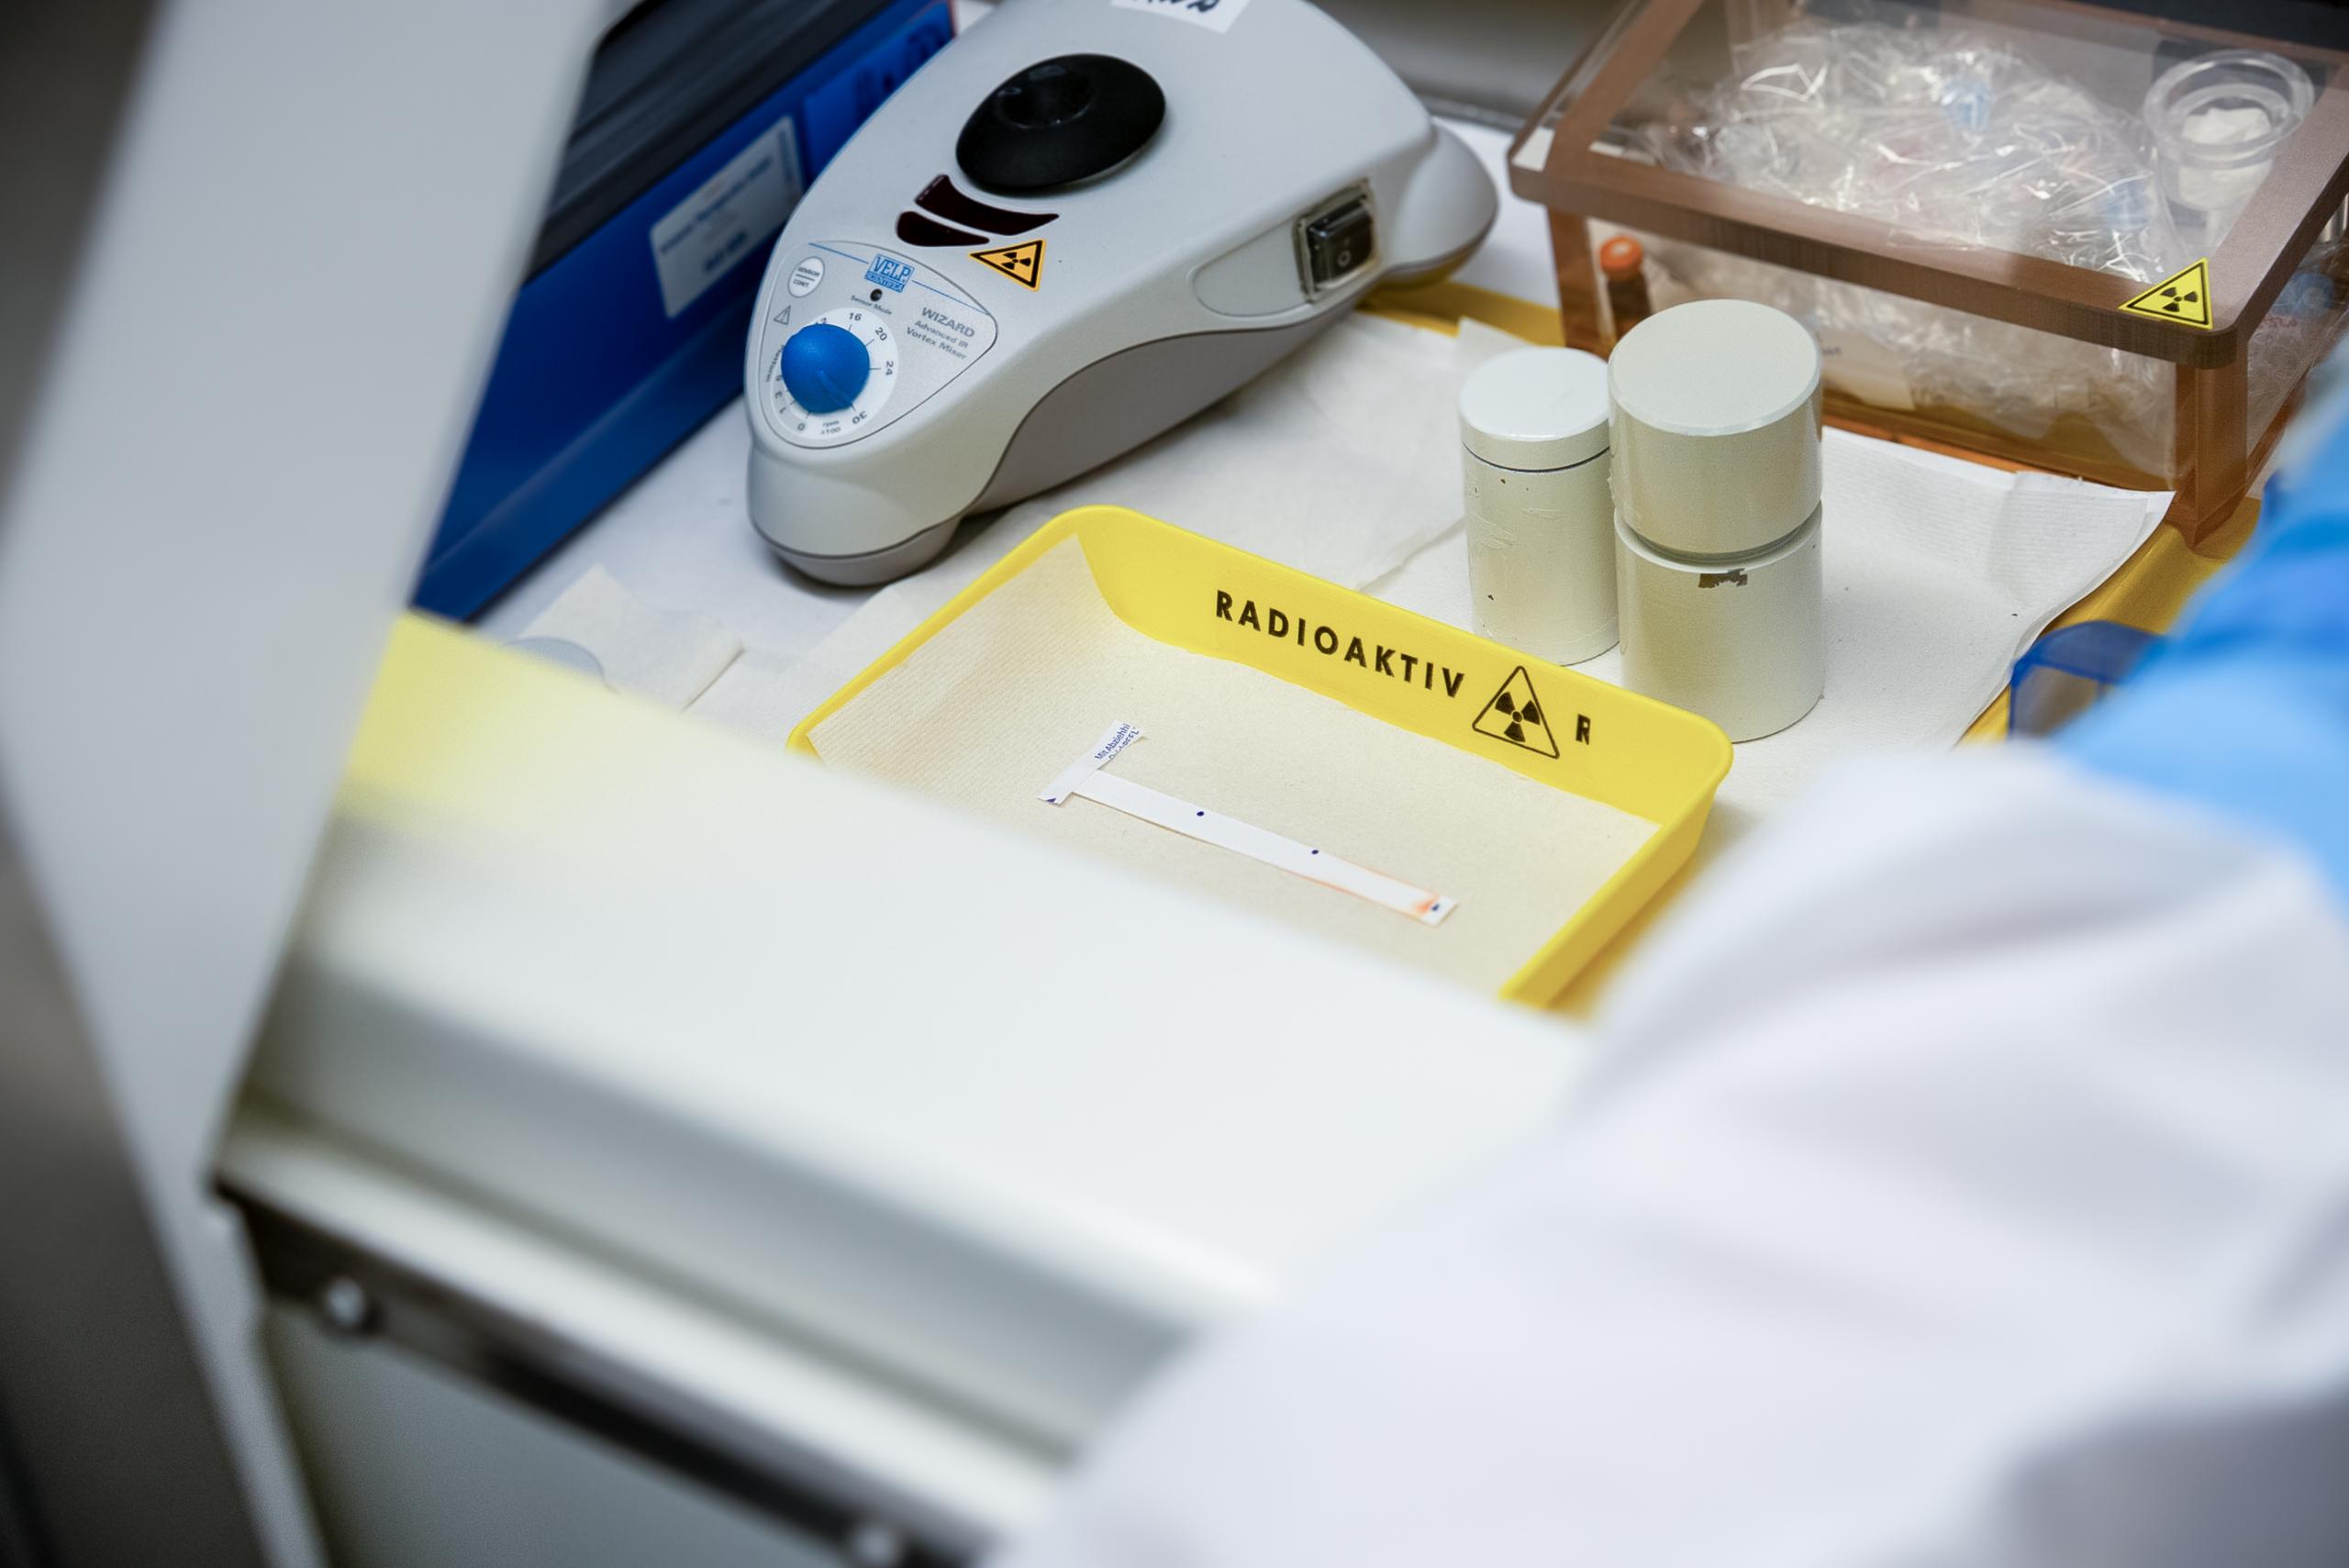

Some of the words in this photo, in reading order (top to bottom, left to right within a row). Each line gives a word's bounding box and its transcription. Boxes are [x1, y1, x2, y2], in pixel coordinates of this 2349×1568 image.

[874, 256, 911, 282] VELP
[849, 312, 863, 321] 16
[851, 295, 872, 307] Sensor
[874, 304, 893, 315] Mode
[915, 320, 957, 343] Advanced
[921, 306, 975, 338] WIZARD
[874, 327, 887, 341] 20
[906, 327, 936, 346] Vortex
[939, 342, 969, 360] Mixer
[885, 361, 894, 375] 24
[852, 410, 867, 425] 30
[1216, 590, 1465, 699] RADIOAKTIV
[1575, 713, 1591, 745] R
